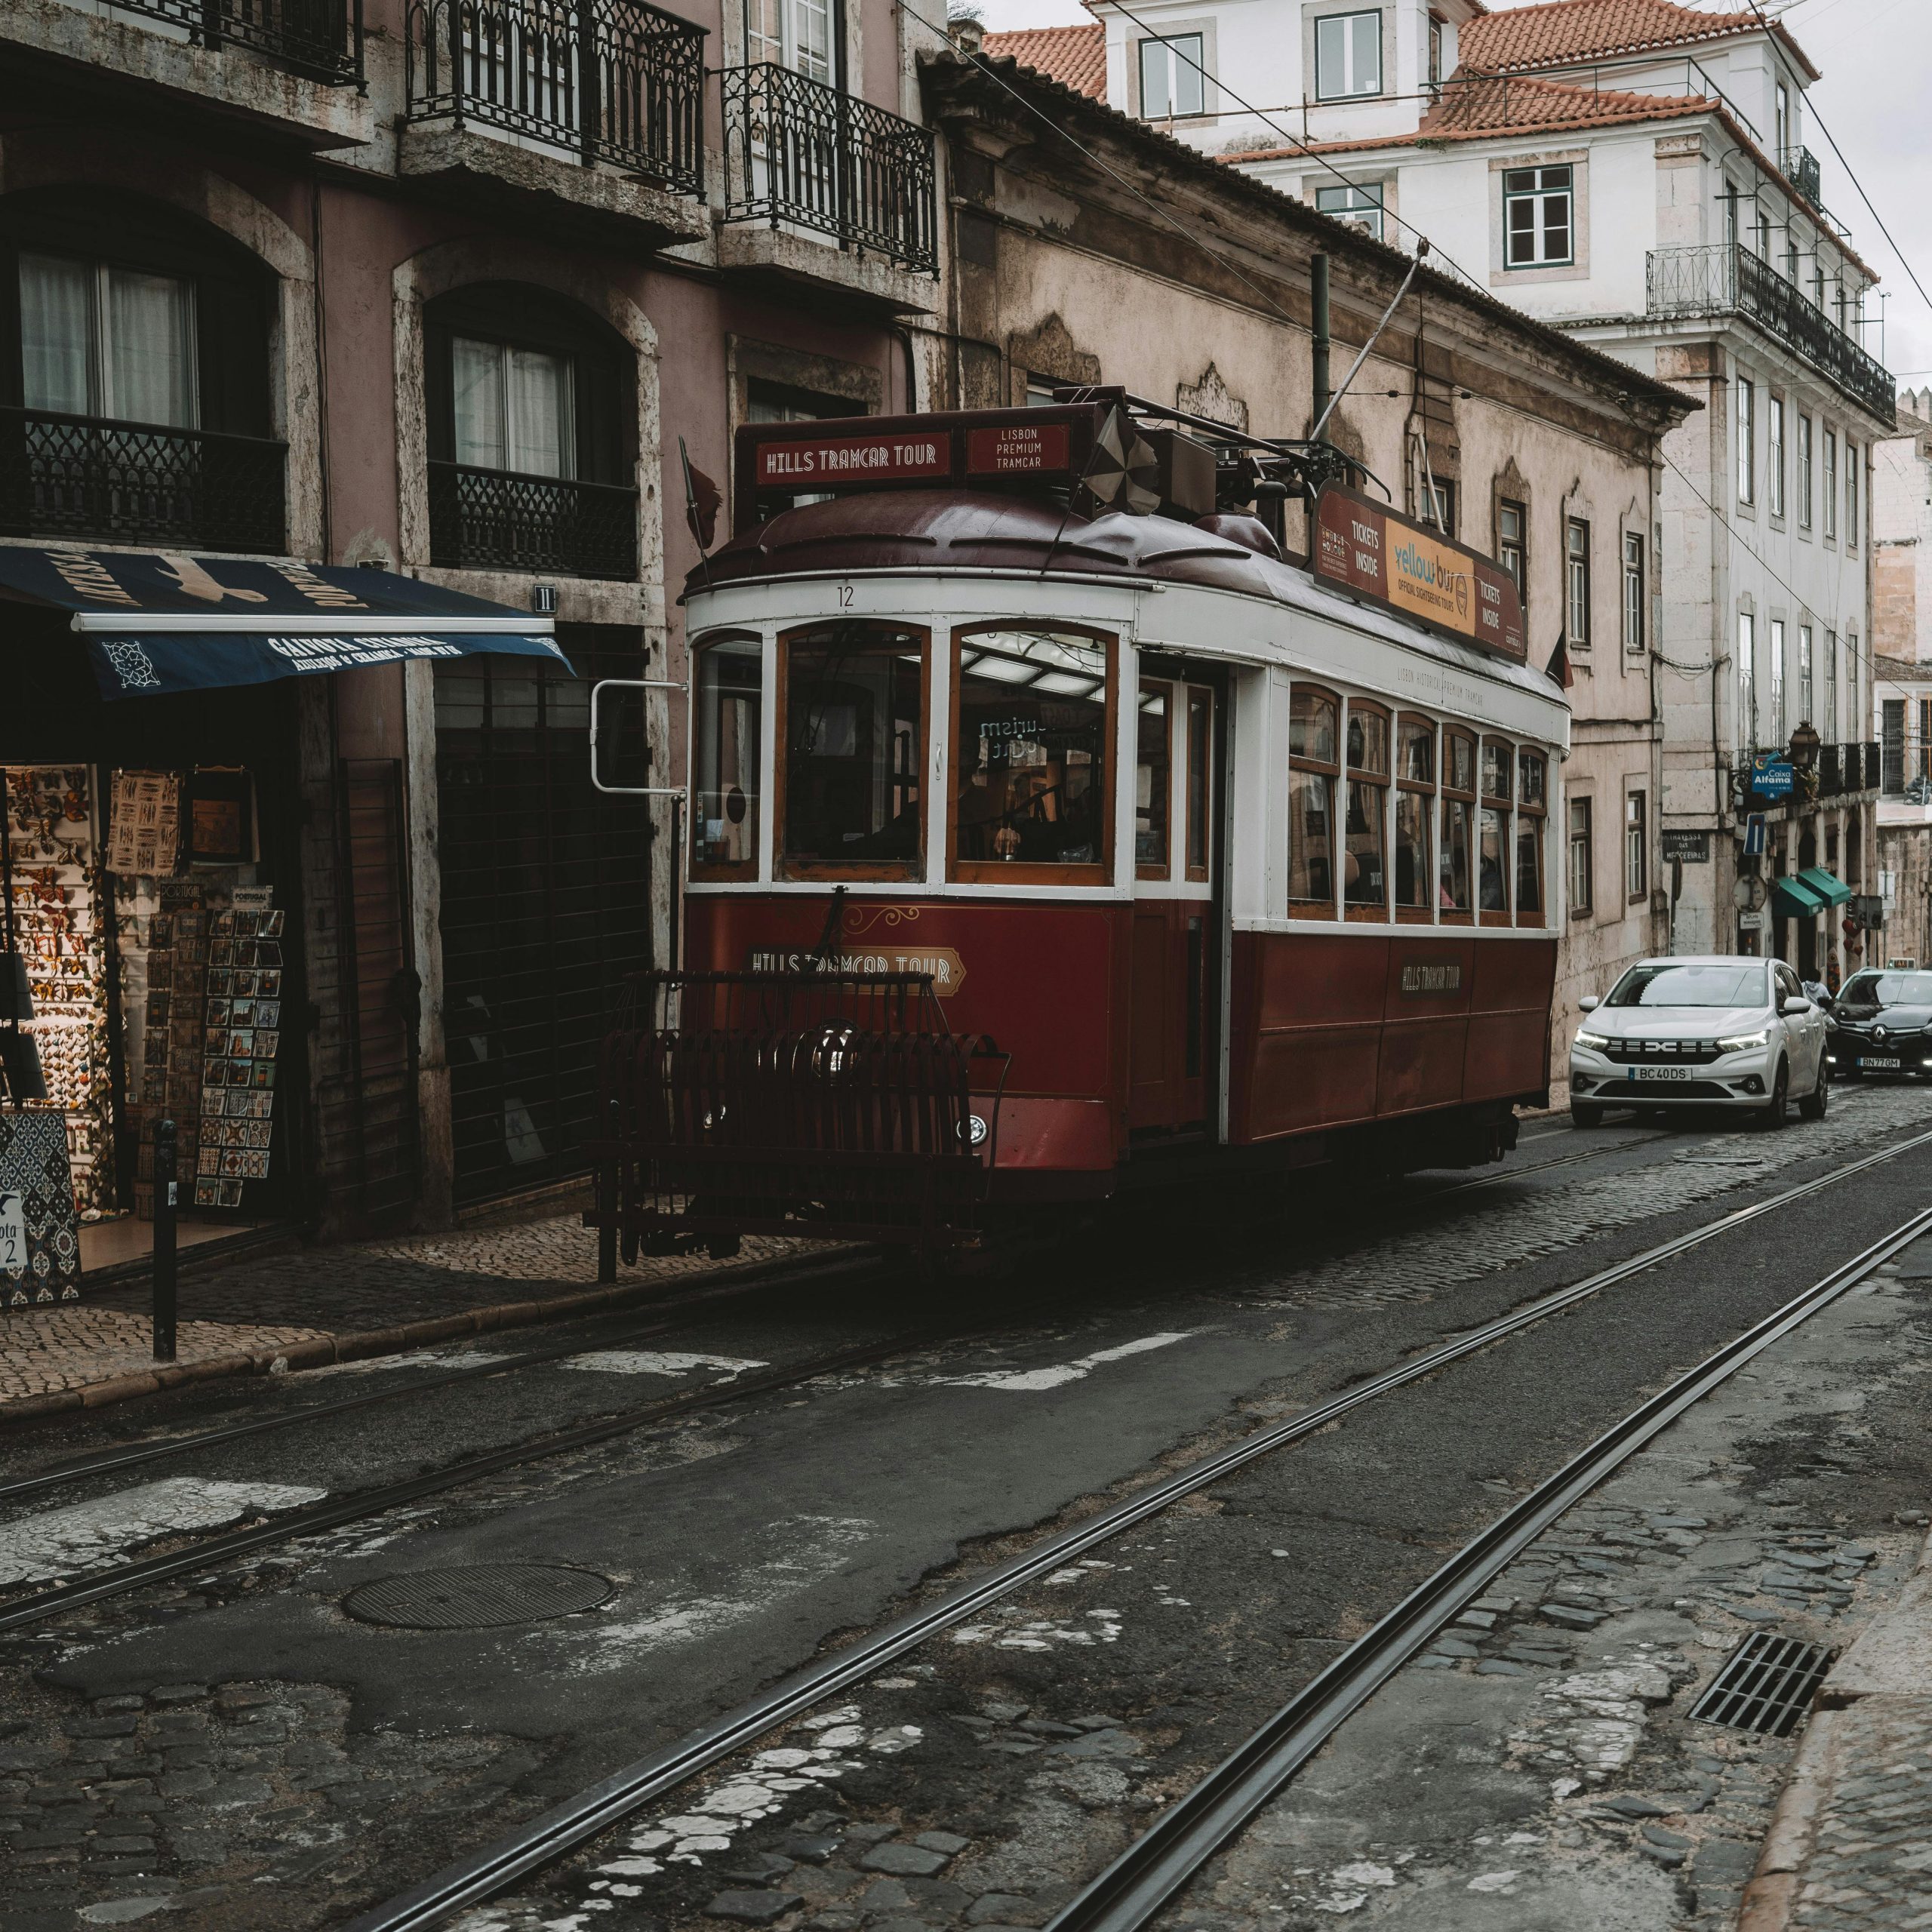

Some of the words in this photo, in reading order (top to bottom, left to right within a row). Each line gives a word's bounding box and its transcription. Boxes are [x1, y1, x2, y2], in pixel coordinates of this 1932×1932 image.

[1001, 428, 1038, 441] LISBON
[767, 451, 814, 474] HILLS
[819, 446, 889, 471] TRAMCAR
[894, 444, 937, 466] TOUR
[996, 442, 1042, 454] PREMIUM
[996, 457, 1041, 469] TRAMCAR
[1352, 519, 1379, 549] TICKETS
[1355, 550, 1378, 577] INSIDE
[540, 588, 550, 610] 11
[837, 586, 854, 607] 12
[1398, 578, 1416, 596] OFFICIAL
[1416, 586, 1441, 607] SIGHTSEEING
[1441, 597, 1454, 612] TOURS
[1481, 581, 1500, 605] TICKETS
[1482, 607, 1500, 629] INSIDE
[267, 638, 362, 657] GAIVOTA
[291, 655, 343, 672] AZULEJOS
[339, 654, 352, 665] &
[1397, 666, 1414, 682] LISBON
[1417, 672, 1441, 691] HISTORICAL
[1444, 680, 1463, 698] PREMIUM
[1465, 688, 1483, 706] TRAMCAR
[1755, 775, 1791, 783] Alfama
[1768, 769, 1791, 777] Caixa
[162, 885, 202, 898] PORTUGAL
[896, 956, 950, 983] TOUR
[1402, 966, 1421, 990] HILLS
[1446, 966, 1460, 989] TOUR
[5, 1240, 17, 1264] 2
